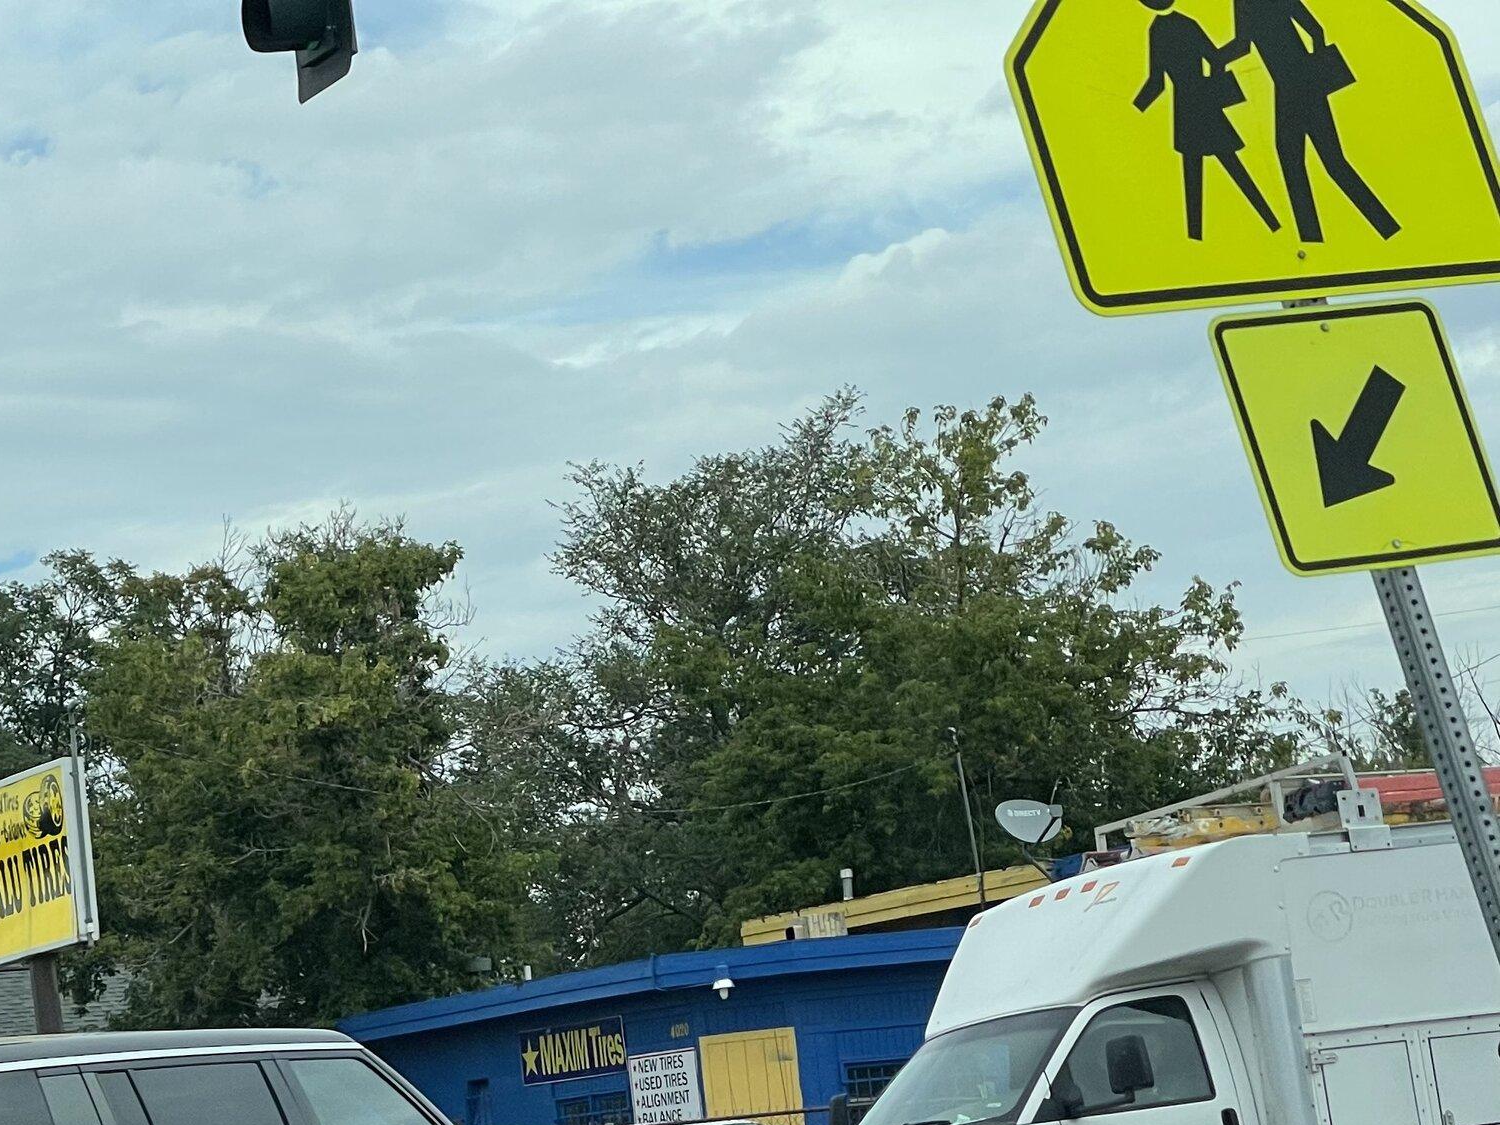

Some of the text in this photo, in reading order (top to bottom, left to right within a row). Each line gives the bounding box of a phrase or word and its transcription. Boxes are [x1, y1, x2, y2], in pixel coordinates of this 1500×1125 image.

[22, 836, 72, 908] TIRES
[539, 1026, 625, 1076] MAXIM Tires
[638, 1054, 684, 1073] NEW TIRES
[639, 1072, 688, 1091] USED TIRES
[641, 1089, 690, 1109] ALIGNMENT
[642, 1108, 682, 1124] BALANCE
